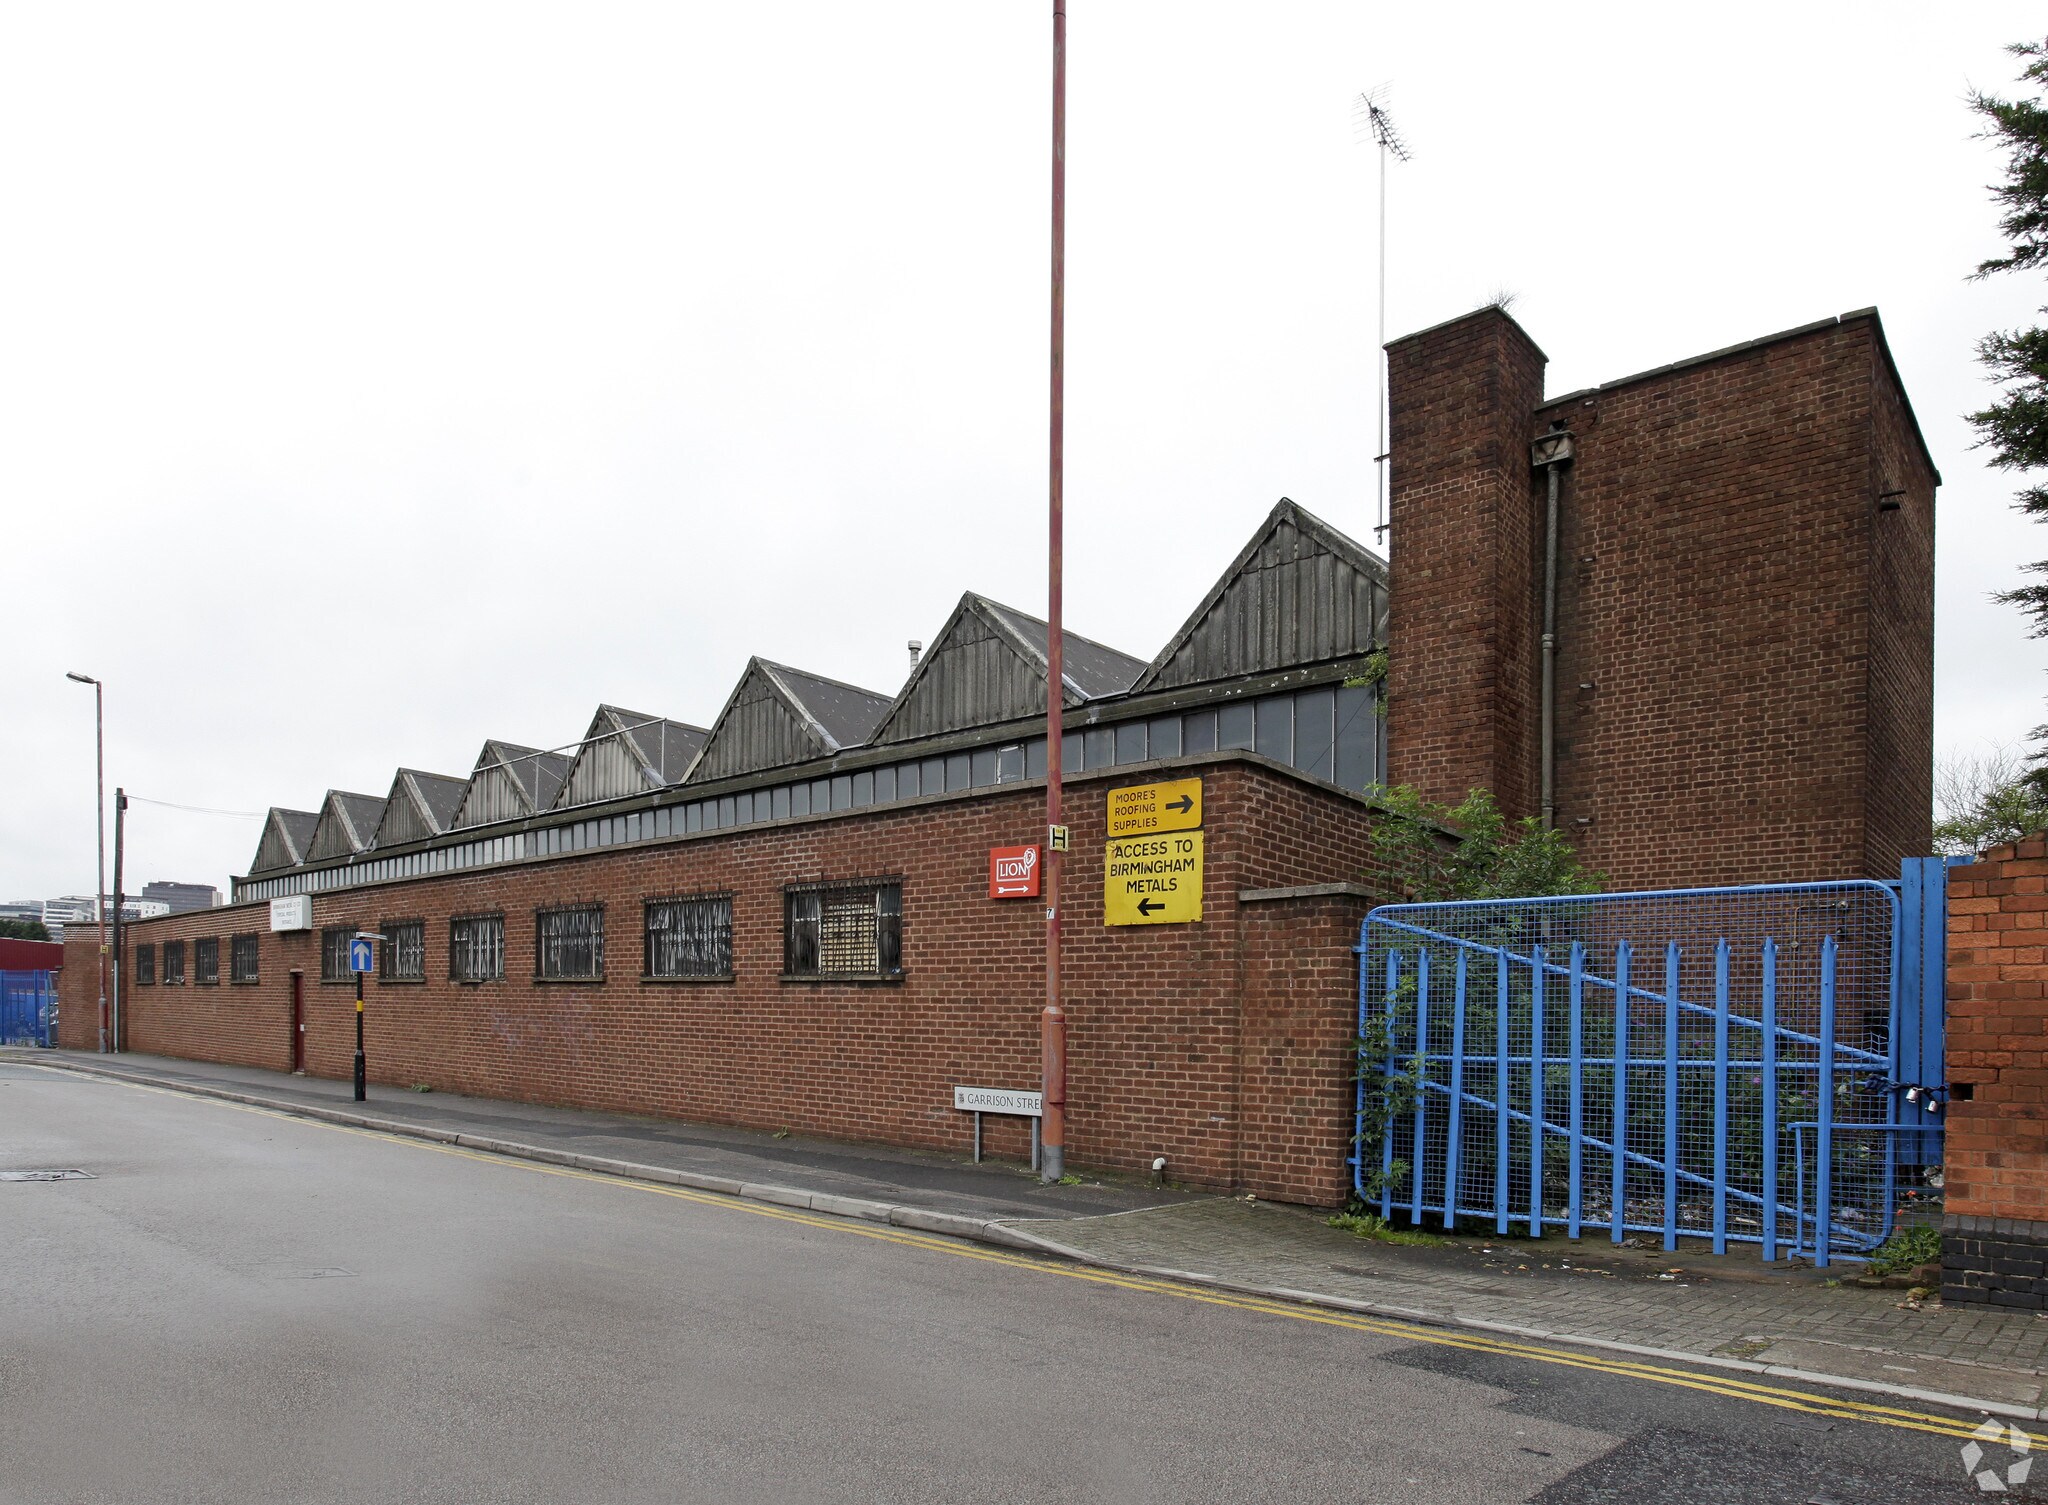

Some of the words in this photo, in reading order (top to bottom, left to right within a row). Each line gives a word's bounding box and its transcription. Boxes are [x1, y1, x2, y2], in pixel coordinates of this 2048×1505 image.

[1115, 789, 1156, 804] MOORE'S
[1114, 803, 1156, 817] ROOFING
[1113, 817, 1158, 831] SUPPLIES
[1052, 827, 1066, 849] H
[1114, 841, 1168, 859] ACCESS
[1174, 839, 1193, 854] TO
[999, 862, 1027, 877] LION
[1110, 857, 1195, 877] BIRMINGHAM
[1126, 877, 1178, 894] METALS
[1047, 908, 1052, 918] 7
[967, 1093, 1014, 1107] GARRISON
